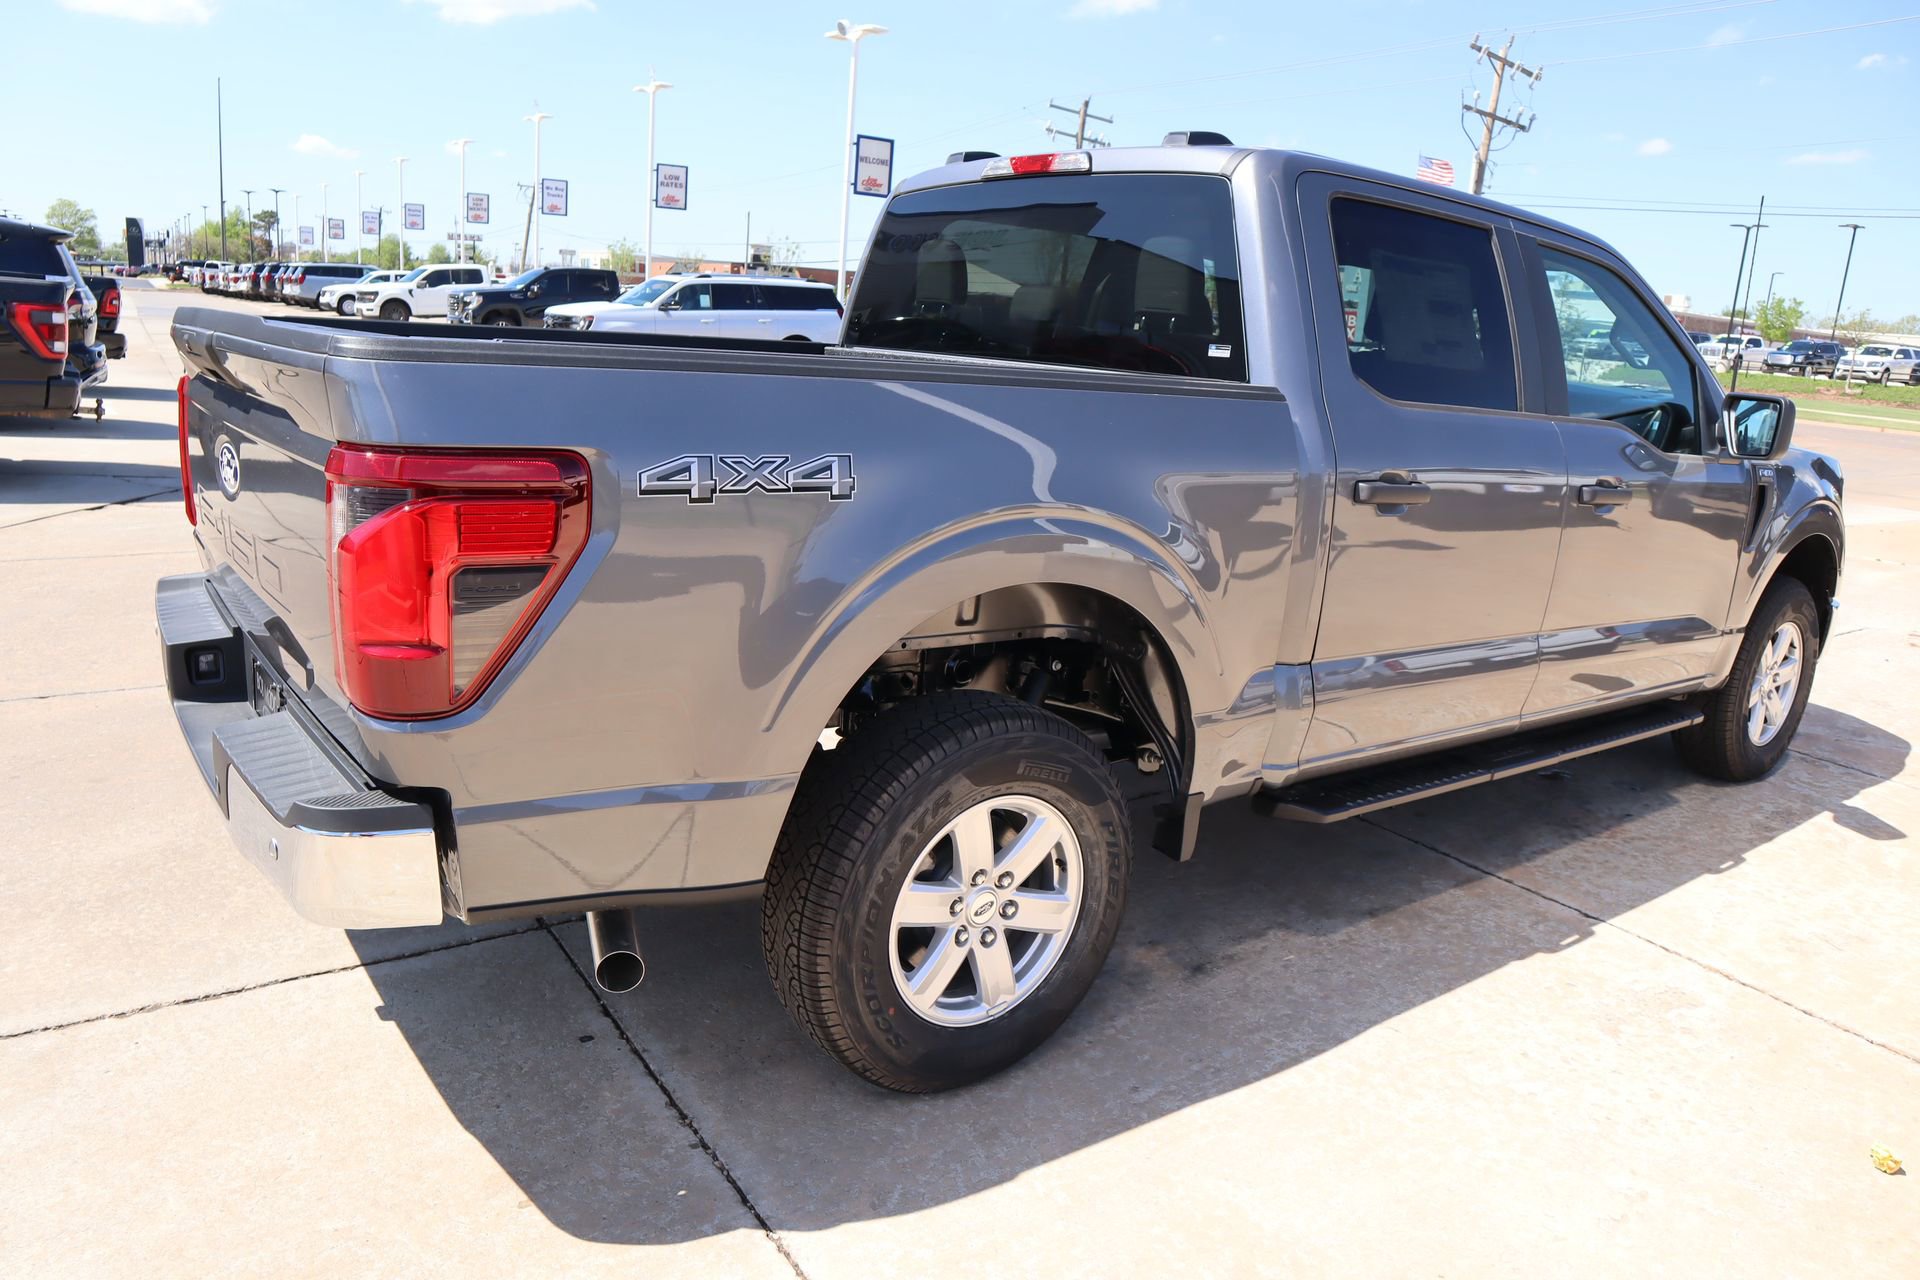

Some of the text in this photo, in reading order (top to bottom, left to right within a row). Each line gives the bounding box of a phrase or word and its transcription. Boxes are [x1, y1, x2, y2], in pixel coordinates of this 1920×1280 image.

[859, 156, 889, 166] WELCOME
[660, 180, 684, 189] RATES
[1016, 759, 1072, 783] PIRELLI
[863, 867, 908, 1050] SCORPION
